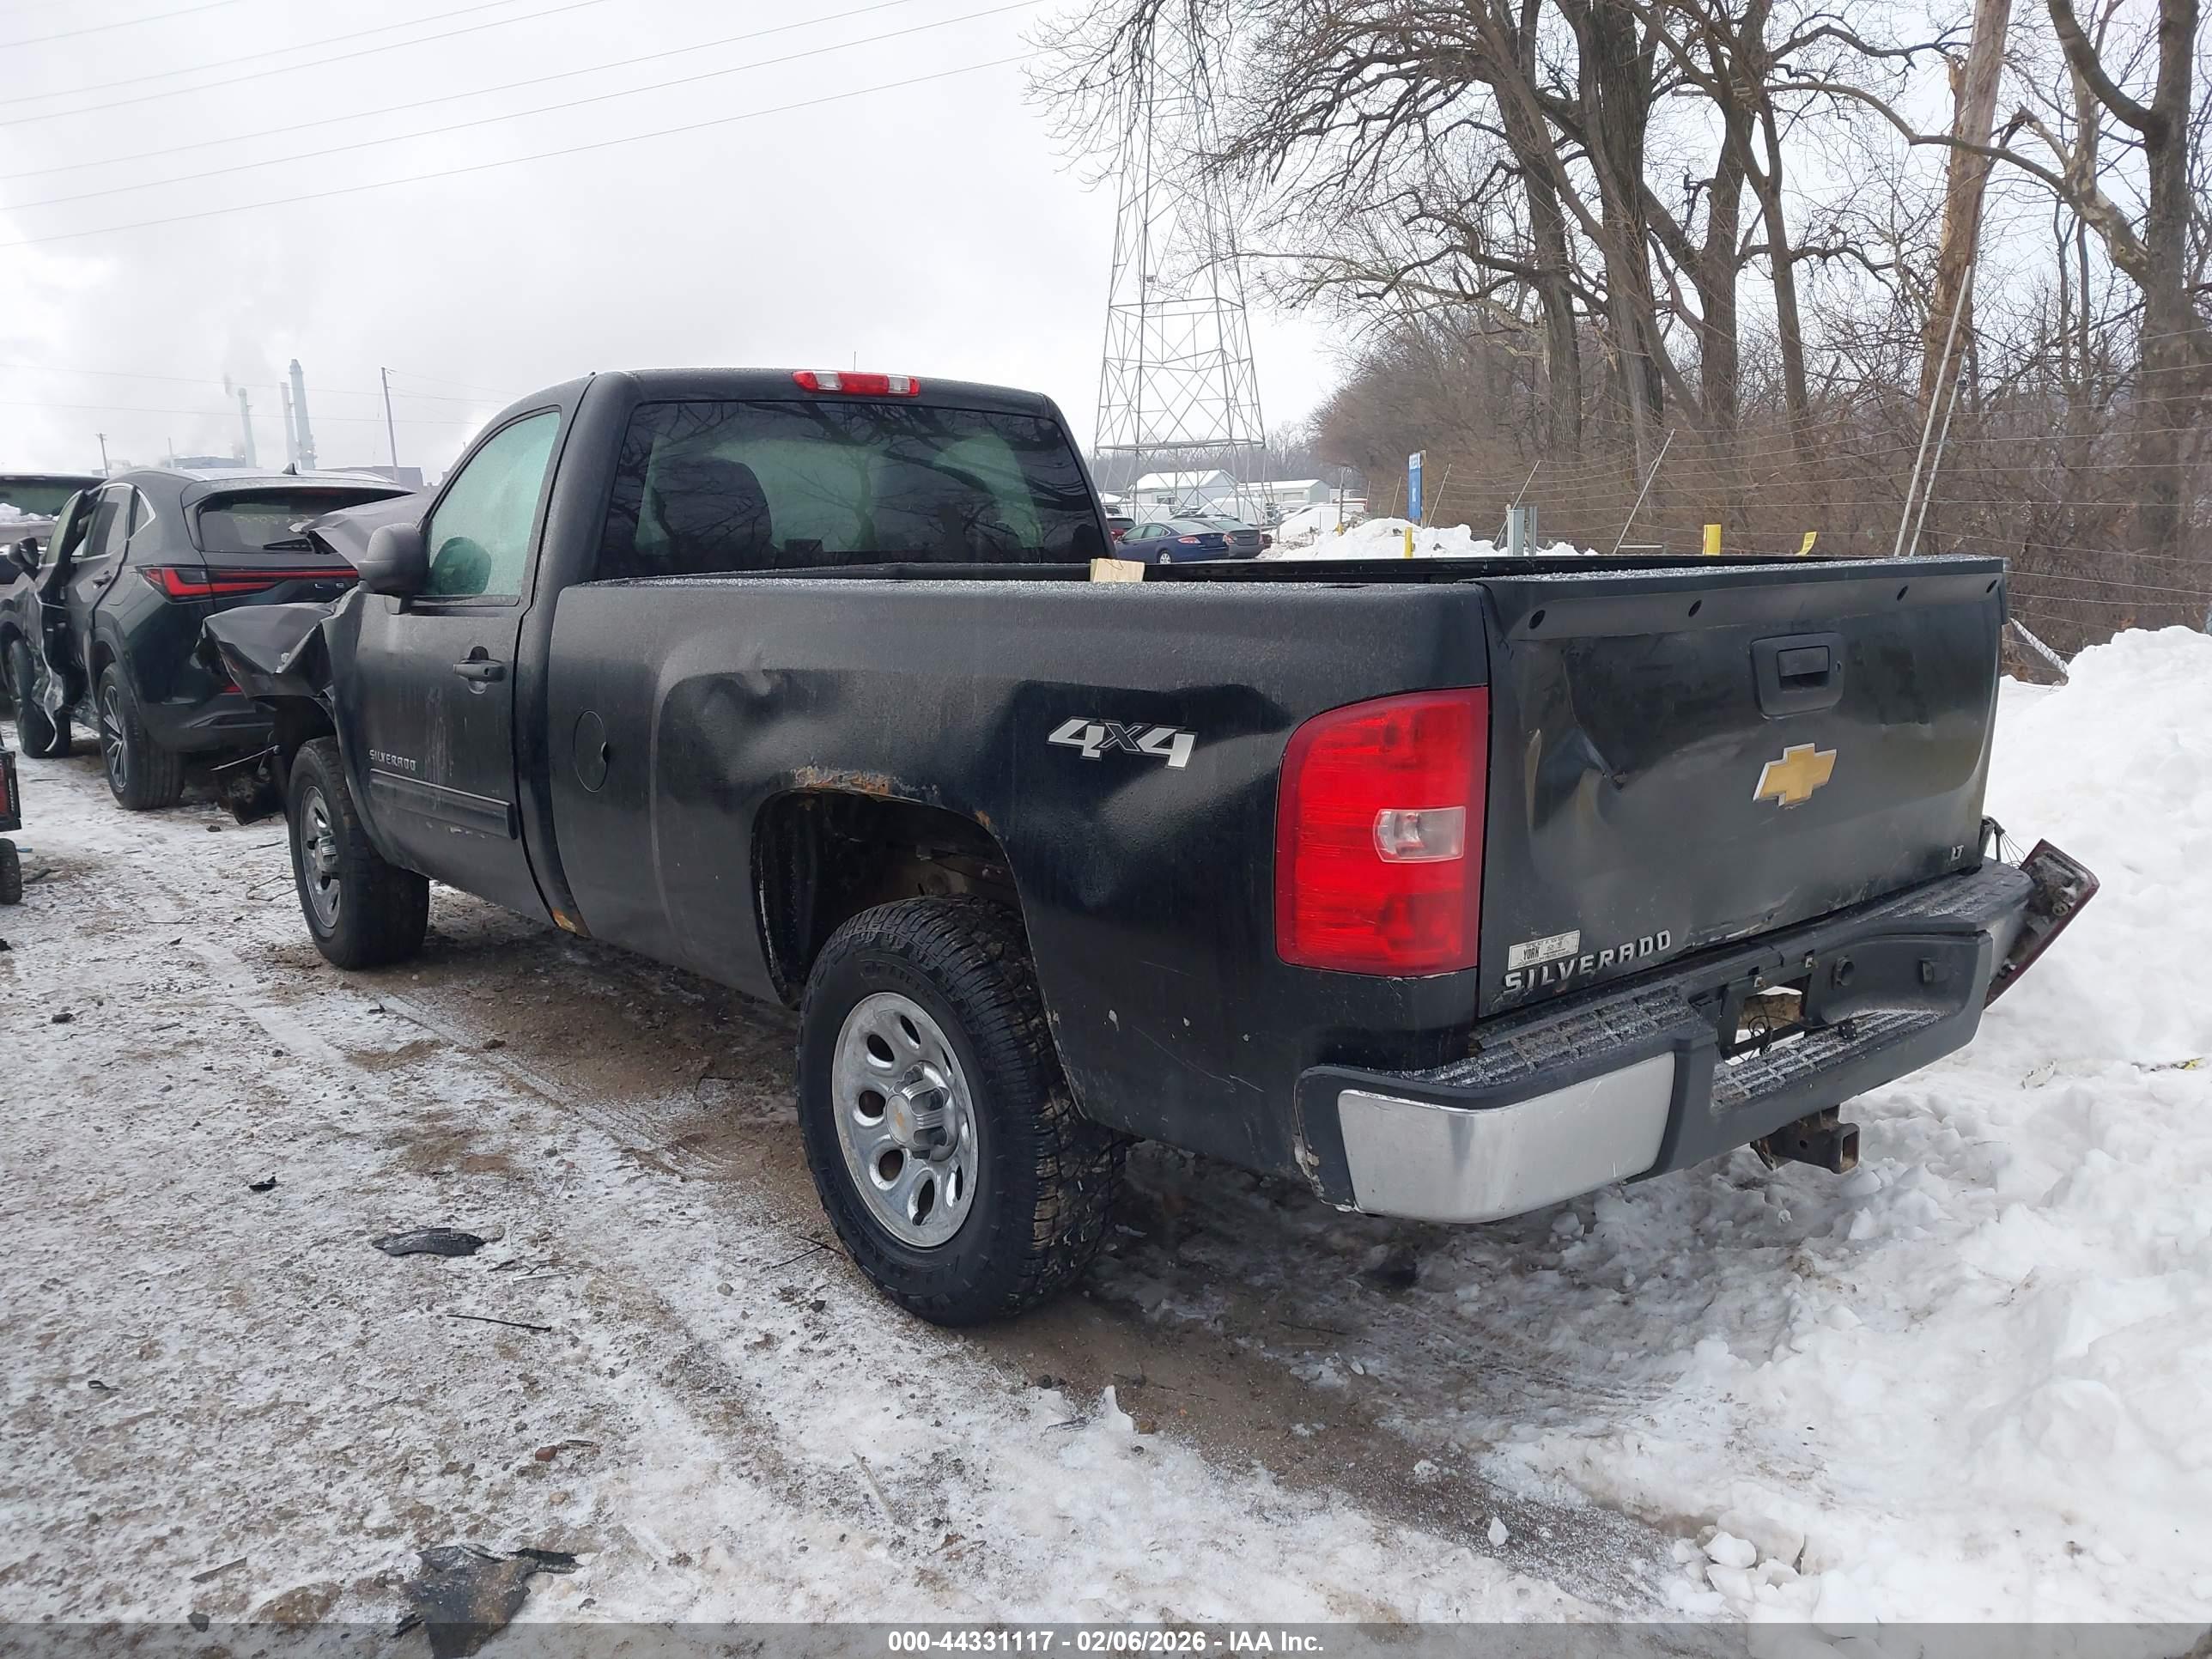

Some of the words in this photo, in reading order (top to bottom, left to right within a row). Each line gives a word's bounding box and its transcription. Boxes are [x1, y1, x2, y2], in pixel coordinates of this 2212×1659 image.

[369, 749, 416, 771] SILVERADO
[1951, 844, 1965, 861] LT
[1504, 929, 1671, 994] SILVERADO
